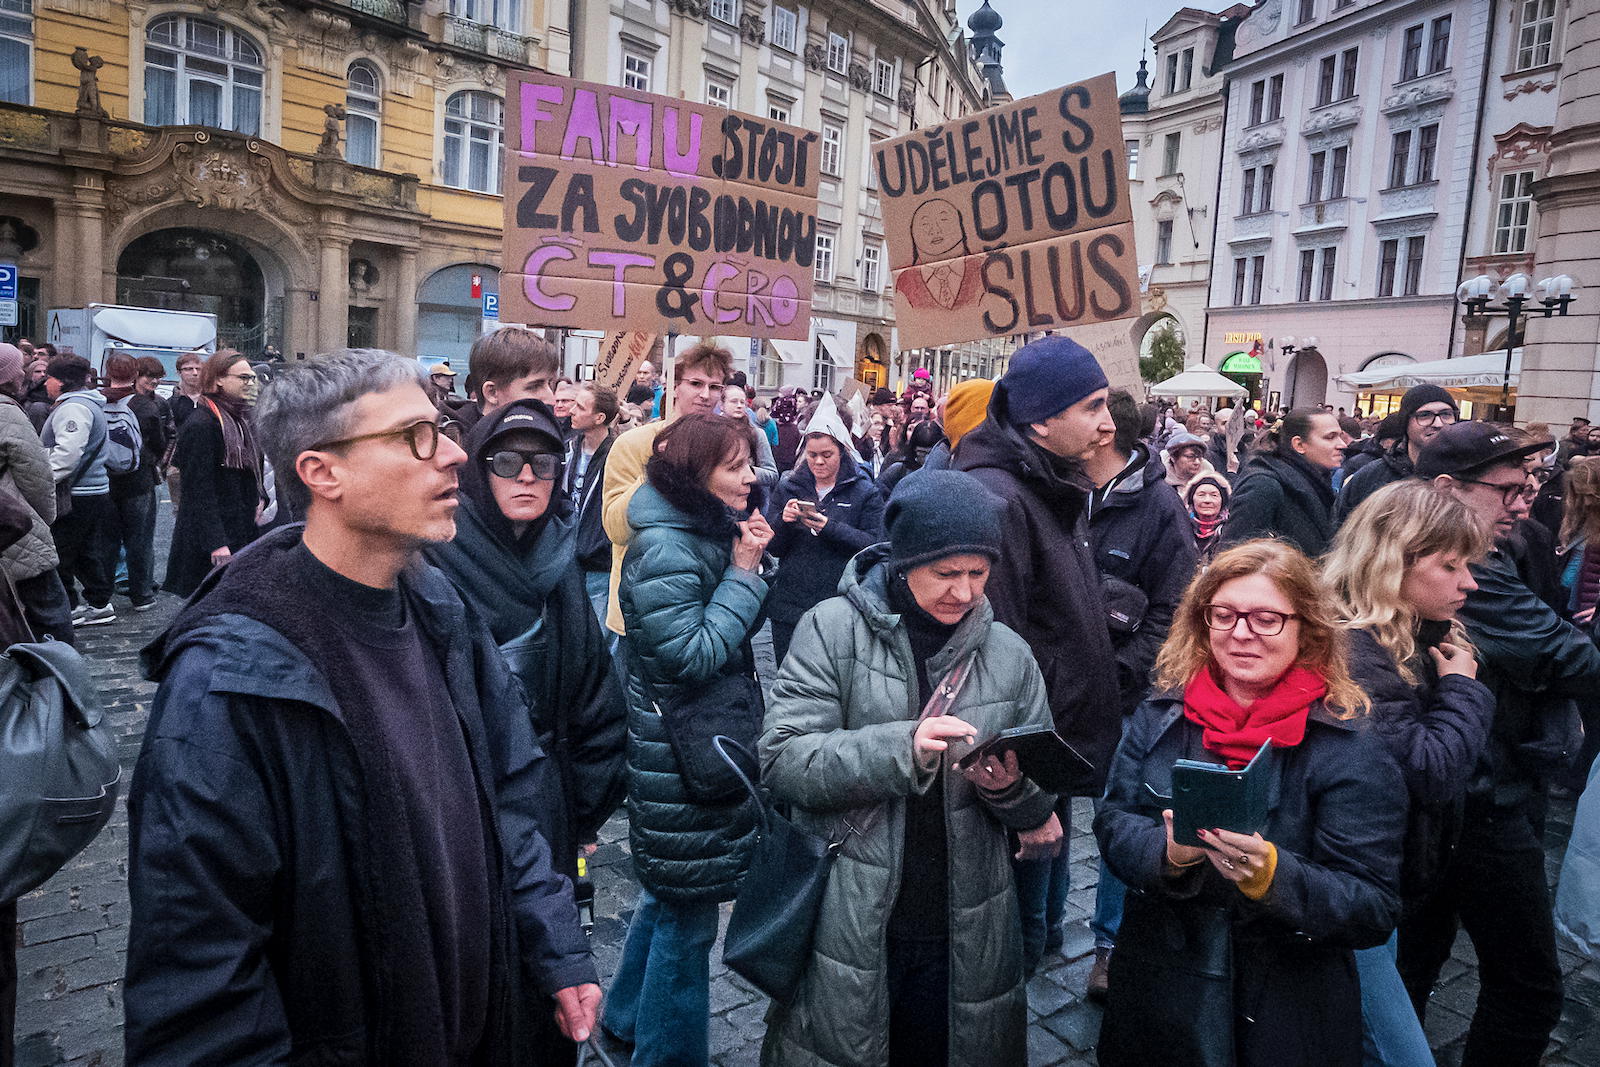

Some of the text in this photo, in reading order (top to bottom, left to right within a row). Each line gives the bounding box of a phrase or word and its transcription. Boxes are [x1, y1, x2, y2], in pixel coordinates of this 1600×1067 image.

[520, 81, 703, 178] FAMU
[876, 85, 1095, 198] UDĚLEJME S
[516, 166, 816, 267] ZA SVOBODNOU
[971, 149, 1118, 243] OTOU
[486, 296, 498, 310] P
[655, 252, 699, 324] &
[980, 234, 1133, 335] ŠLUS
